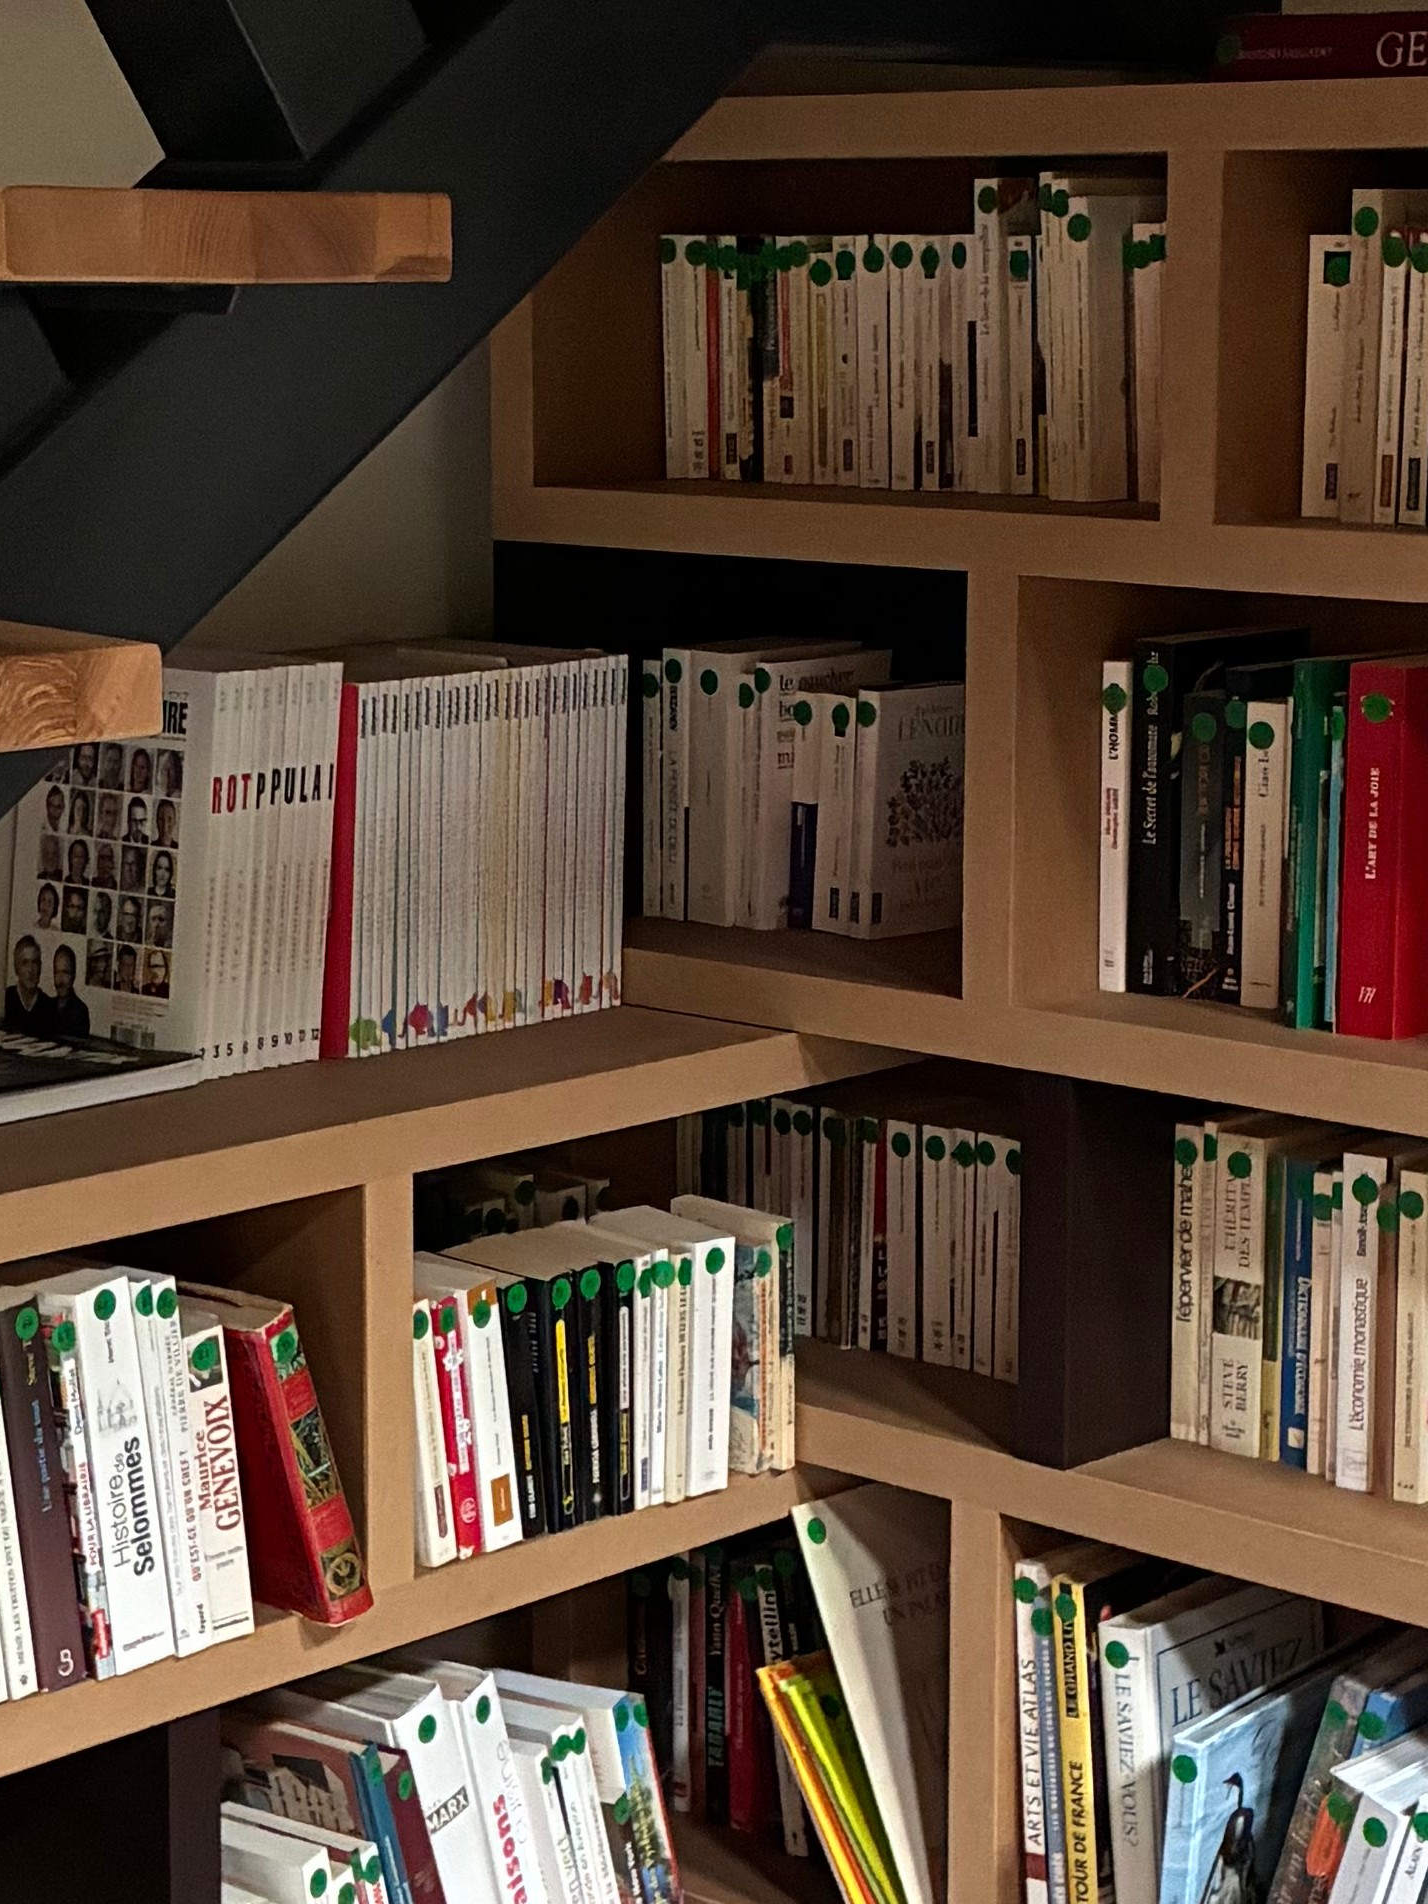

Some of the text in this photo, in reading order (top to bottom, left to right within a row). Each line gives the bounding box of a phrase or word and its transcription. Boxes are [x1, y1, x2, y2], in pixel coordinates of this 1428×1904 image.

[1142, 796, 1158, 830] Secret
[1364, 767, 1381, 880] L'ART DE LA JOIE
[226, 1042, 234, 1057] 5
[1348, 1278, 1369, 1430] L'économie monastique
[1222, 1359, 1234, 1410] STEVE
[1234, 1362, 1249, 1413] BERRY
[194, 1428, 212, 1511] Maurice
[203, 1394, 242, 1533] GENEVOIX
[77, 1460, 99, 1567] POUR LIBRAIRIE
[107, 1452, 131, 1568] Histoire de
[123, 1435, 155, 1577] Selommes
[708, 1622, 722, 1656] Yann
[1115, 1672, 1134, 1698] LE
[1171, 1678, 1203, 1728] LE
[708, 1685, 724, 1768] TABARLY
[1020, 1658, 1044, 1847] ARTS ET VIE ATLAS
[1068, 1759, 1085, 1828] FRANCE
[556, 1835, 575, 1876] vert
[1072, 1832, 1088, 1855] DE
[568, 1879, 584, 1904] en
[1073, 1857, 1090, 1904] TOUR
